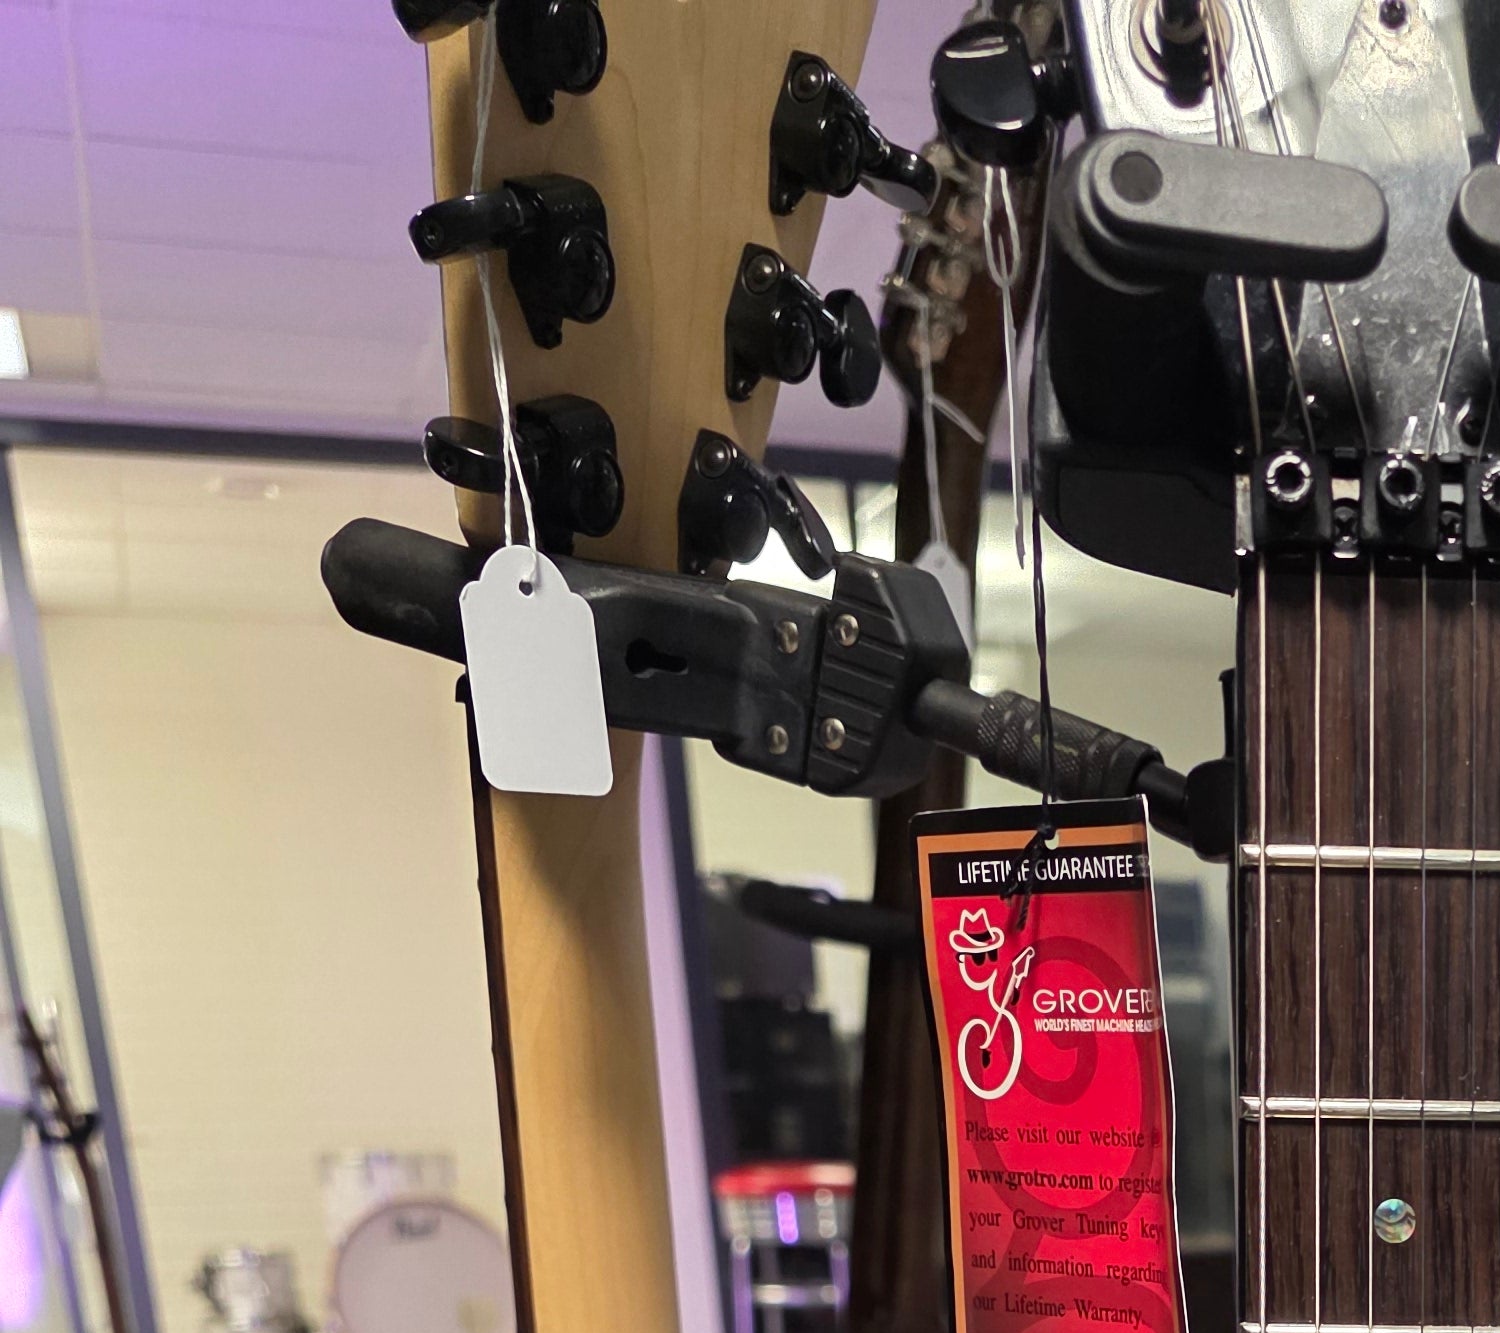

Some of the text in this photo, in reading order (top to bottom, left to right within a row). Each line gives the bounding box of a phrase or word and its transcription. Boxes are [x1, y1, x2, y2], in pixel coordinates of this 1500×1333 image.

[1035, 855, 1135, 881] GUARANTEE
[1070, 1018, 1095, 1032] FINEST
[1096, 1019, 1134, 1032] MACHINE
[965, 1120, 1009, 1142] Please
[1017, 1122, 1049, 1144] visit
[1056, 1129, 1082, 1145] our
[1090, 1125, 1145, 1149] website
[966, 1167, 1094, 1191] www.grotro.com
[1099, 1173, 1114, 1191] to
[968, 1211, 1002, 1232] your
[1013, 1209, 1065, 1233] Grover
[1075, 1213, 1129, 1242] Tuning
[971, 1250, 996, 1269] and
[1008, 1252, 1094, 1278] information
[973, 1295, 997, 1312] our
[1004, 1292, 1066, 1317] Lifetime
